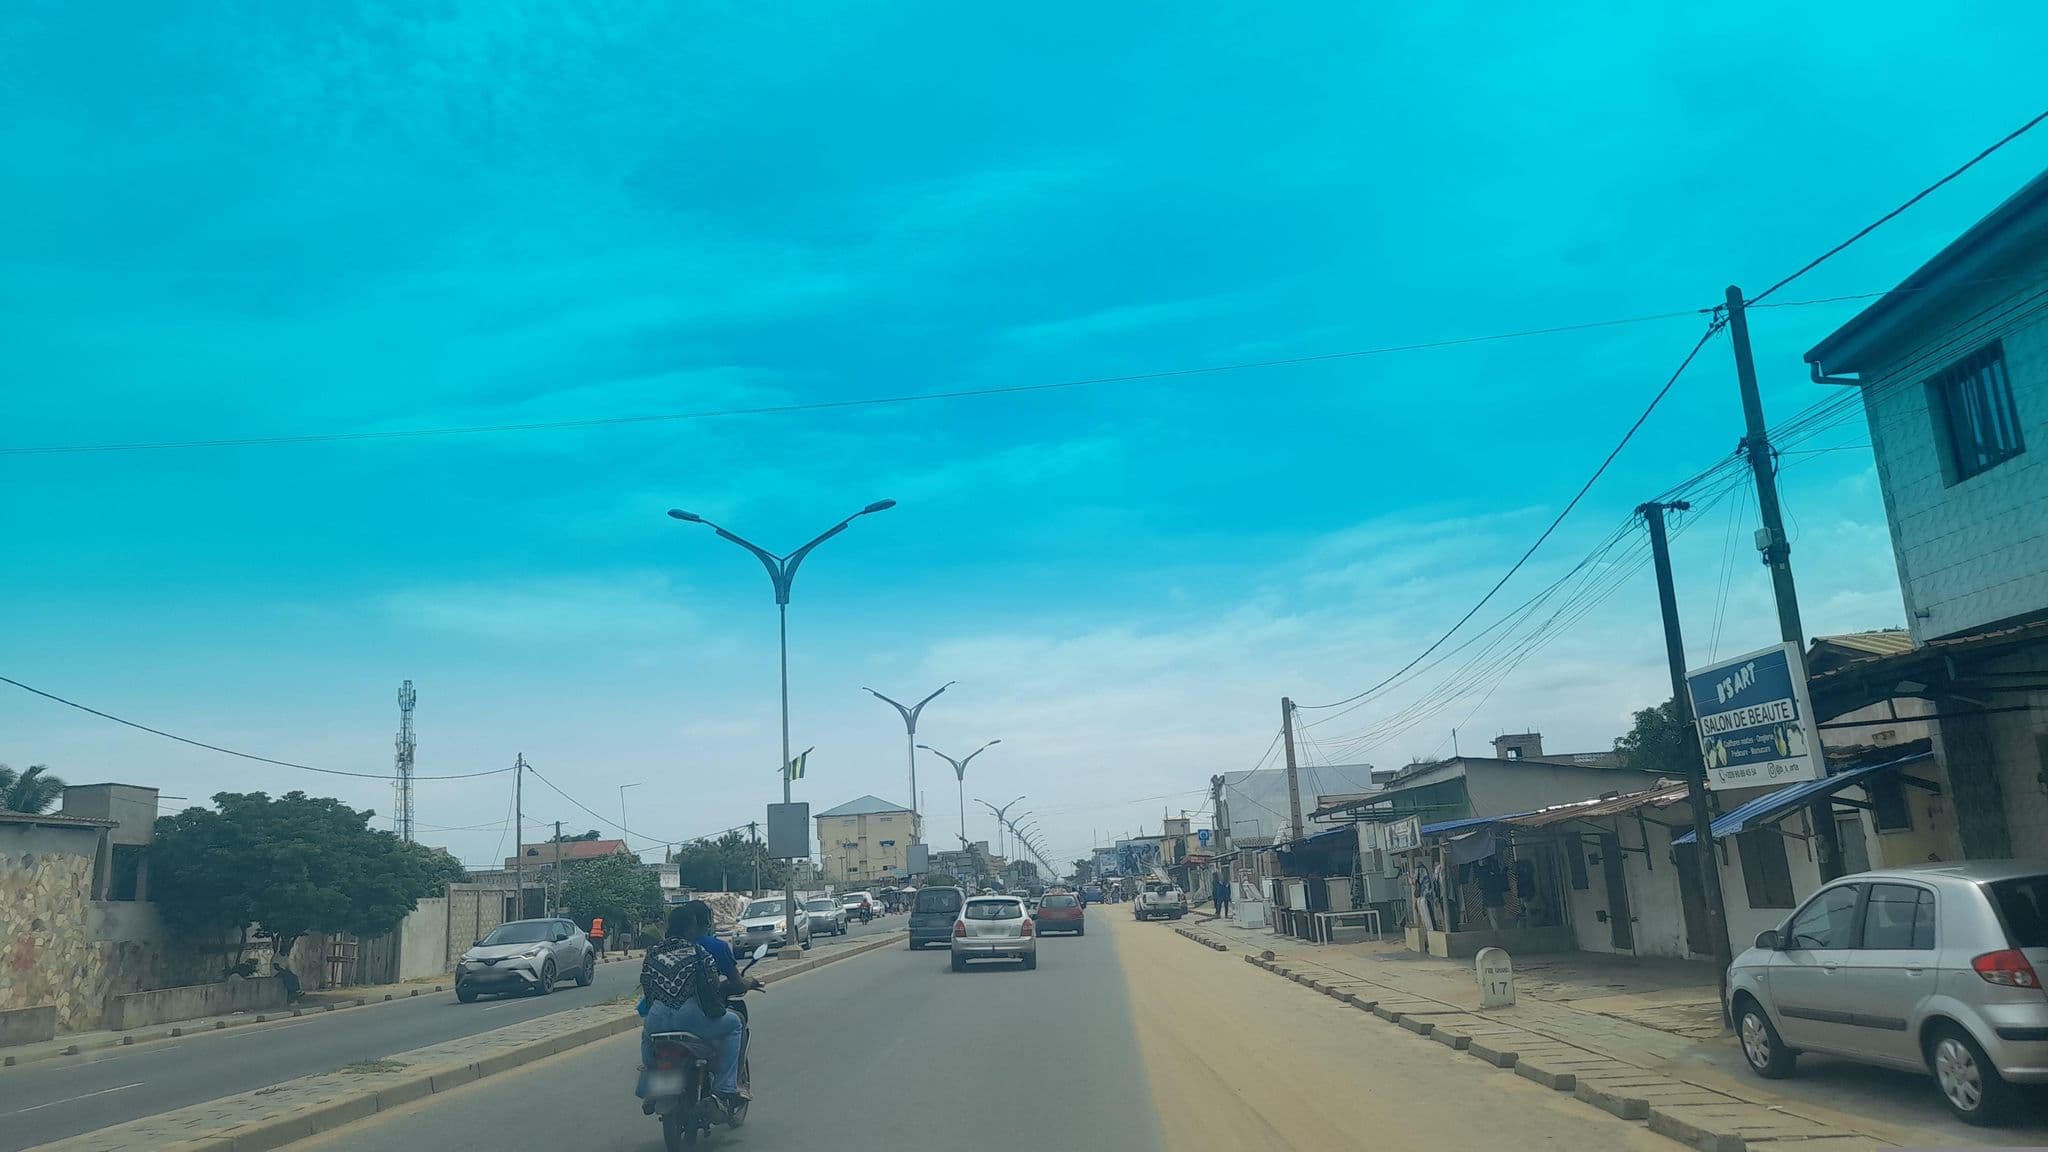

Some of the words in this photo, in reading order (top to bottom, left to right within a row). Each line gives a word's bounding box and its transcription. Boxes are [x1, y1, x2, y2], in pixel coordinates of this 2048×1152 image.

[1734, 662, 1755, 693] ART
[1703, 714, 1732, 734] SALON
[1735, 711, 1746, 727] DE
[1748, 701, 1790, 725] BEAUTE
[1491, 981, 1508, 996] 17
